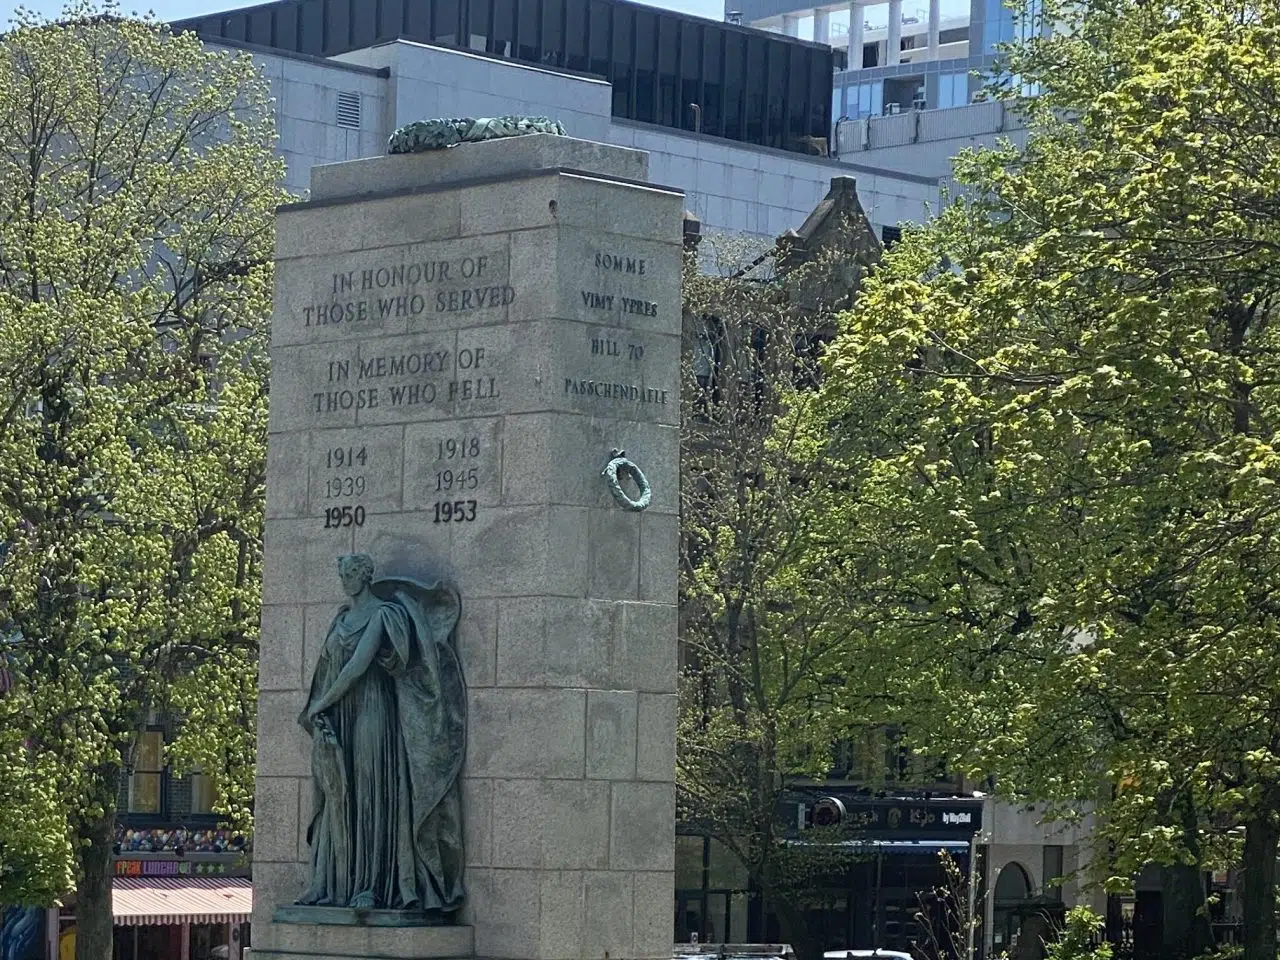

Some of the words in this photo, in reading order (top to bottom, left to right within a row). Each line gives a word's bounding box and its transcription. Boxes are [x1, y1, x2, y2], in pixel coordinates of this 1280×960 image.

[332, 272, 354, 294] IN
[361, 261, 453, 290] HONOUR
[461, 256, 488, 279] OF
[595, 252, 646, 275] SOMME
[303, 301, 368, 327] THOSE
[378, 294, 425, 319] WHO
[435, 286, 516, 313] SERVED
[581, 290, 615, 311] VIMY
[621, 297, 658, 318] YPRES
[328, 360, 350, 382] IN
[358, 351, 449, 380] MEMORY
[458, 348, 486, 370] OF
[591, 338, 620, 357] HILL
[628, 343, 644, 361] 70
[313, 388, 379, 413] THOSE
[388, 383, 437, 406] WHO
[448, 377, 501, 402] FELL
[326, 446, 368, 468] 1914
[438, 437, 481, 460] 1918
[325, 475, 366, 498] 1939
[435, 467, 479, 492] 1945
[324, 505, 366, 529] 1950
[433, 500, 478, 523] 1953
